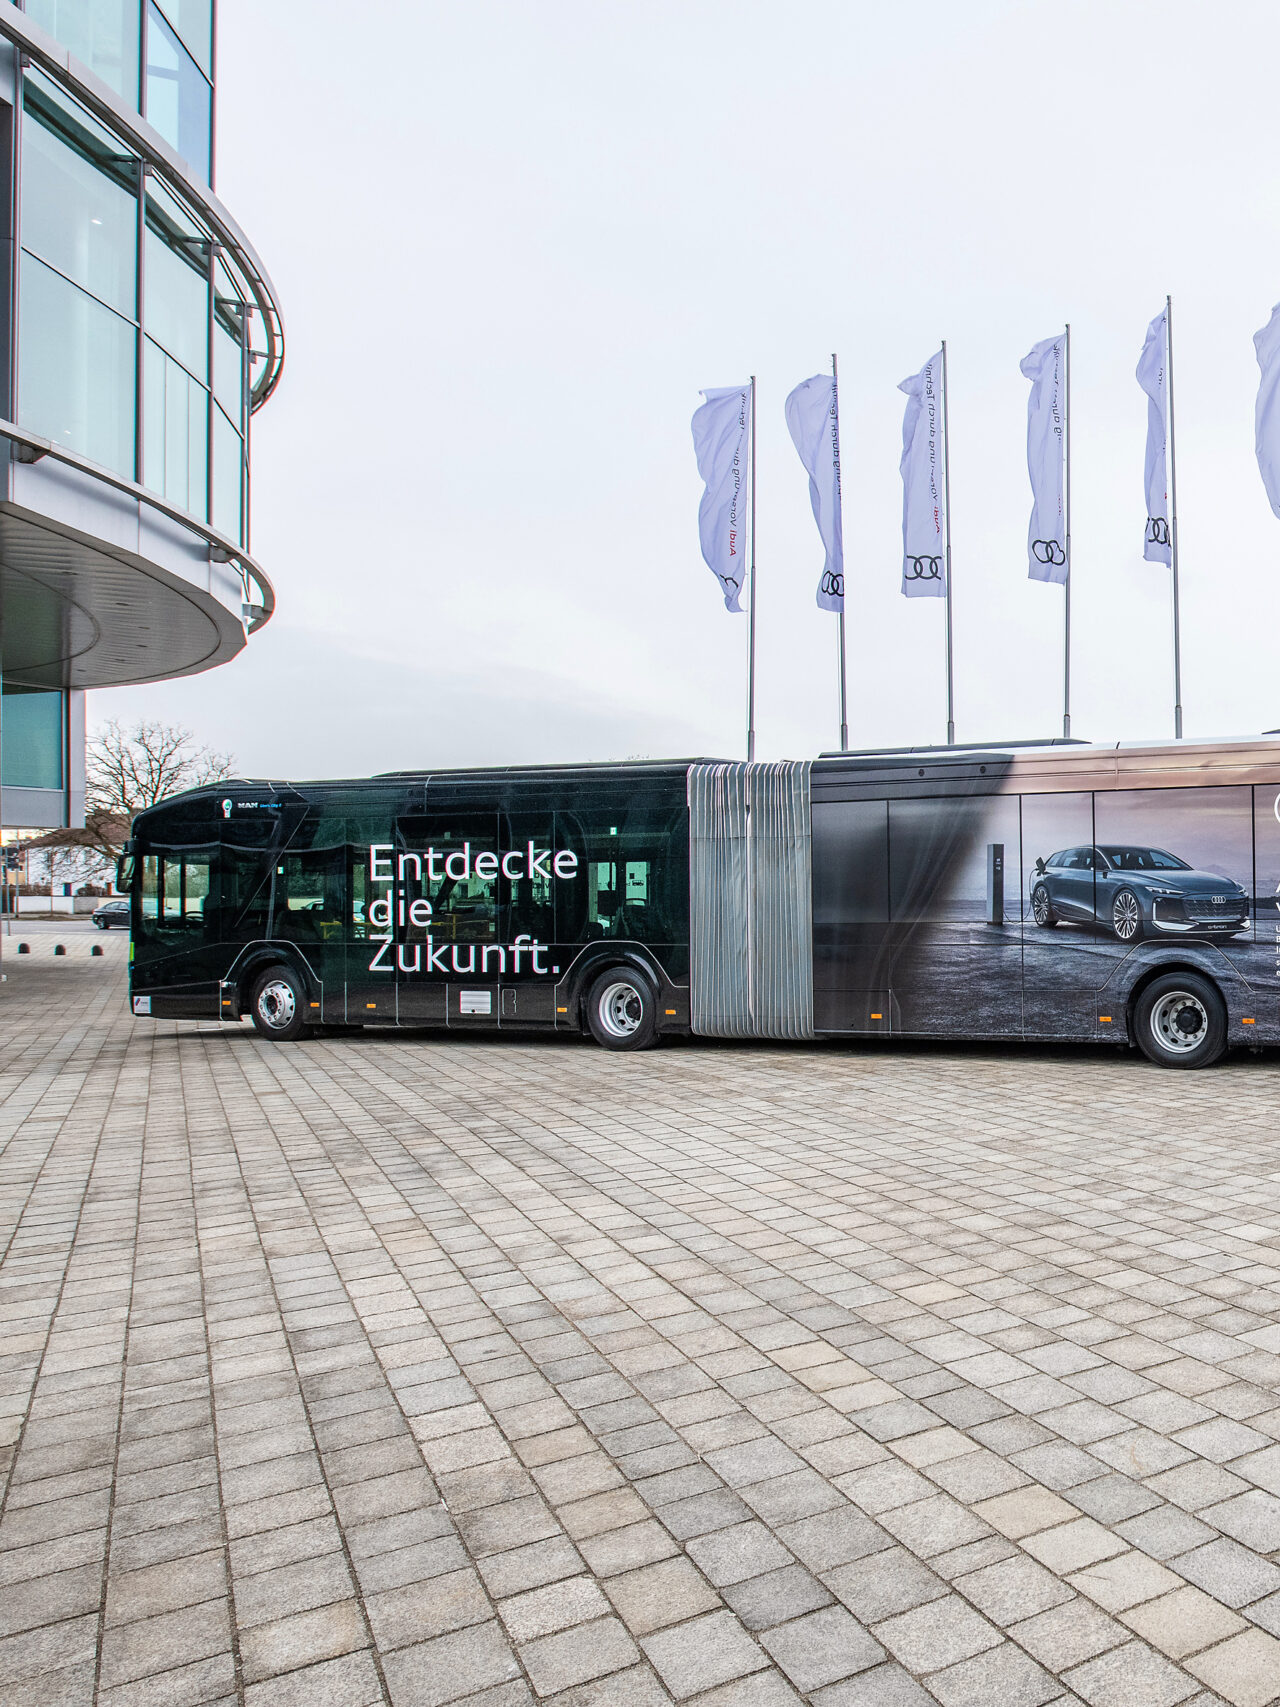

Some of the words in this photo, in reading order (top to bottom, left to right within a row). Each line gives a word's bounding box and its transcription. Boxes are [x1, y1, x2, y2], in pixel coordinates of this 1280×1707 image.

[370, 840, 578, 881] Entdecke
[368, 889, 433, 927] die
[368, 934, 560, 974] Zukunft.
